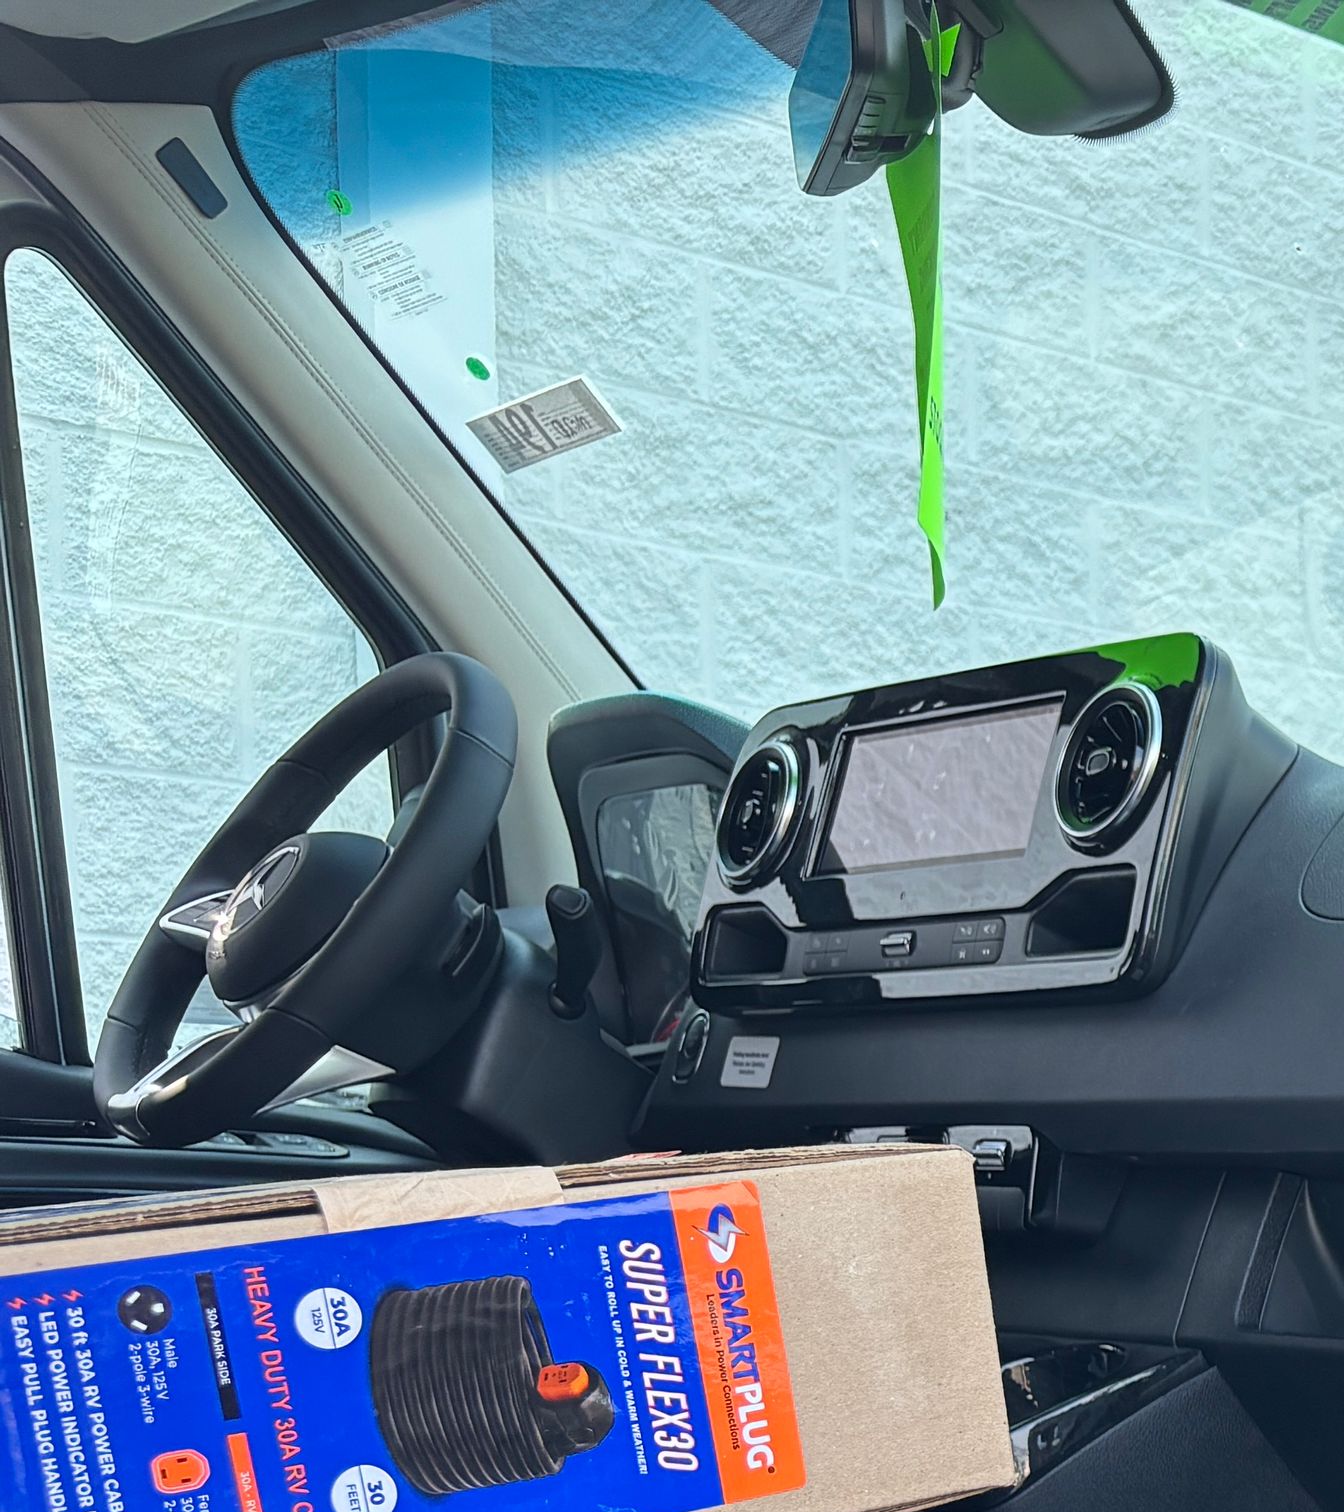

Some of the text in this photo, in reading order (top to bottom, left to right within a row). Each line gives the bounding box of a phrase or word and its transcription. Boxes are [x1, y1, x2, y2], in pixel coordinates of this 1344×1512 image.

[66, 1306, 85, 1328] 30
[243, 1266, 280, 1343] HEAVY
[310, 1306, 326, 1334] 125V
[330, 1296, 351, 1338] 30A
[10, 1315, 35, 1359] EASY
[38, 1311, 60, 1345] LED
[71, 1331, 89, 1346] ft
[205, 1307, 232, 1386] 30A PARK SIDE
[75, 1348, 96, 1383] 30A
[144, 1340, 162, 1369] 30A,
[162, 1338, 178, 1369] Male
[598, 1245, 649, 1476] EASY TO ROLL UP IN COLD & WARM WEATHER!
[618, 1239, 700, 1472] SUPER FLEX30
[706, 1293, 741, 1451] Leaders in Power Connections
[715, 1267, 775, 1470] SMARTPLUG
[19, 1362, 44, 1407] PULL
[46, 1349, 74, 1414] POWER
[82, 1385, 103, 1408] RV
[128, 1342, 156, 1425] 2-pole 3-wire
[259, 1349, 294, 1411] DUTY
[30, 1409, 55, 1455] PLUG
[89, 1412, 116, 1476] POWER
[273, 1417, 302, 1461] 30A
[61, 1416, 95, 1509] INDICATOR
[240, 1471, 253, 1492] 30A
[283, 1464, 311, 1495] RV
[346, 1483, 362, 1512] FEET
[367, 1480, 386, 1506] 30
